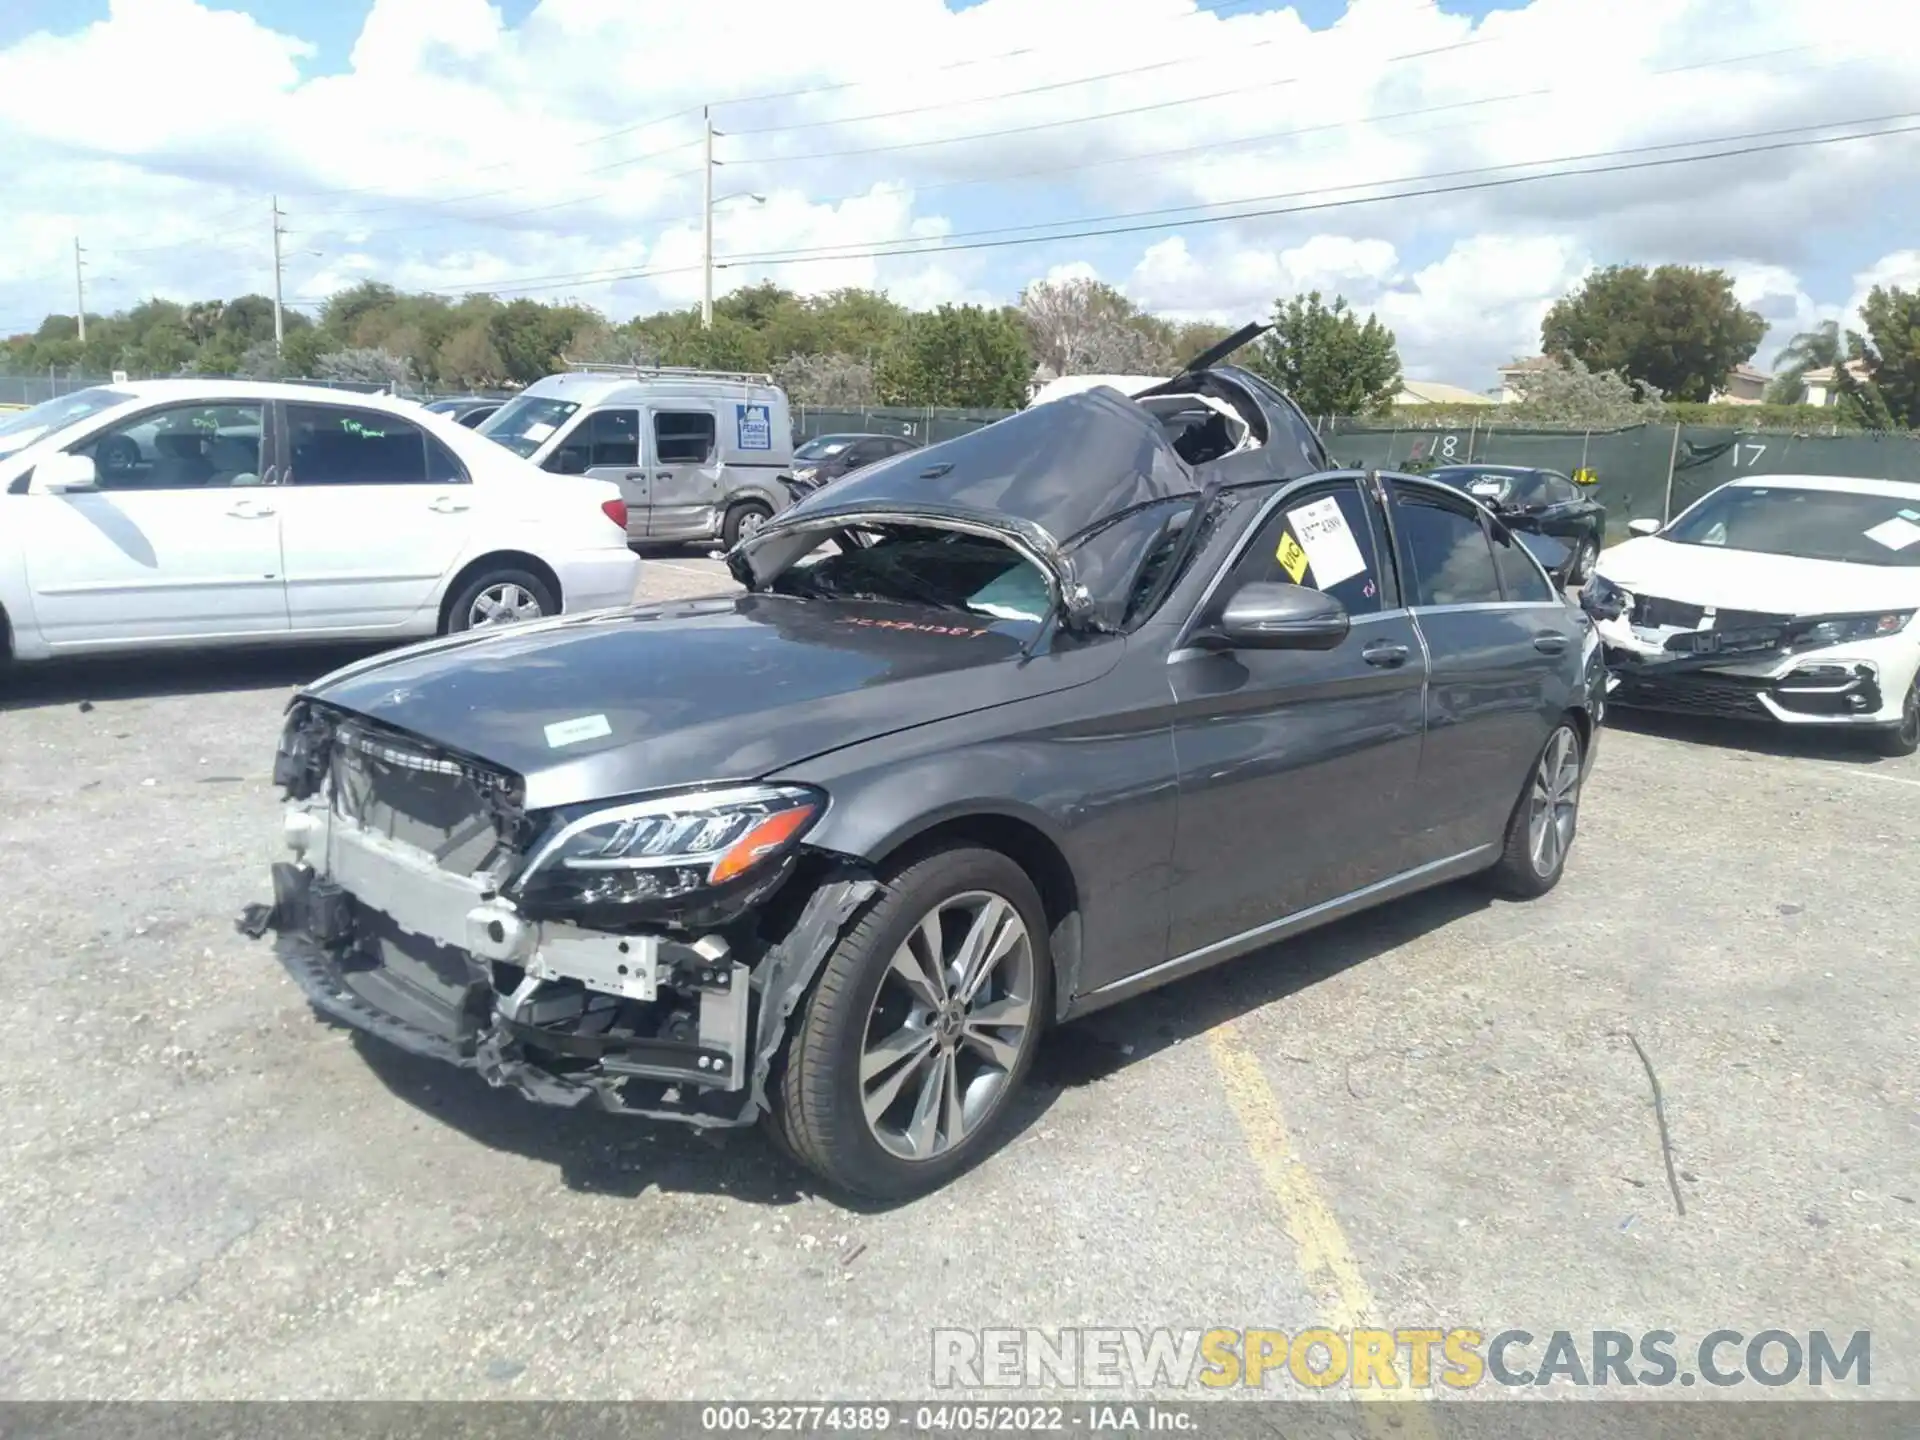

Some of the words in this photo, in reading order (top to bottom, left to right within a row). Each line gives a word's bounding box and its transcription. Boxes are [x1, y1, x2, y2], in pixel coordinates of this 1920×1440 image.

[903, 422, 917, 437] 21
[1428, 435, 1458, 457] 18
[1732, 442, 1766, 467] 17
